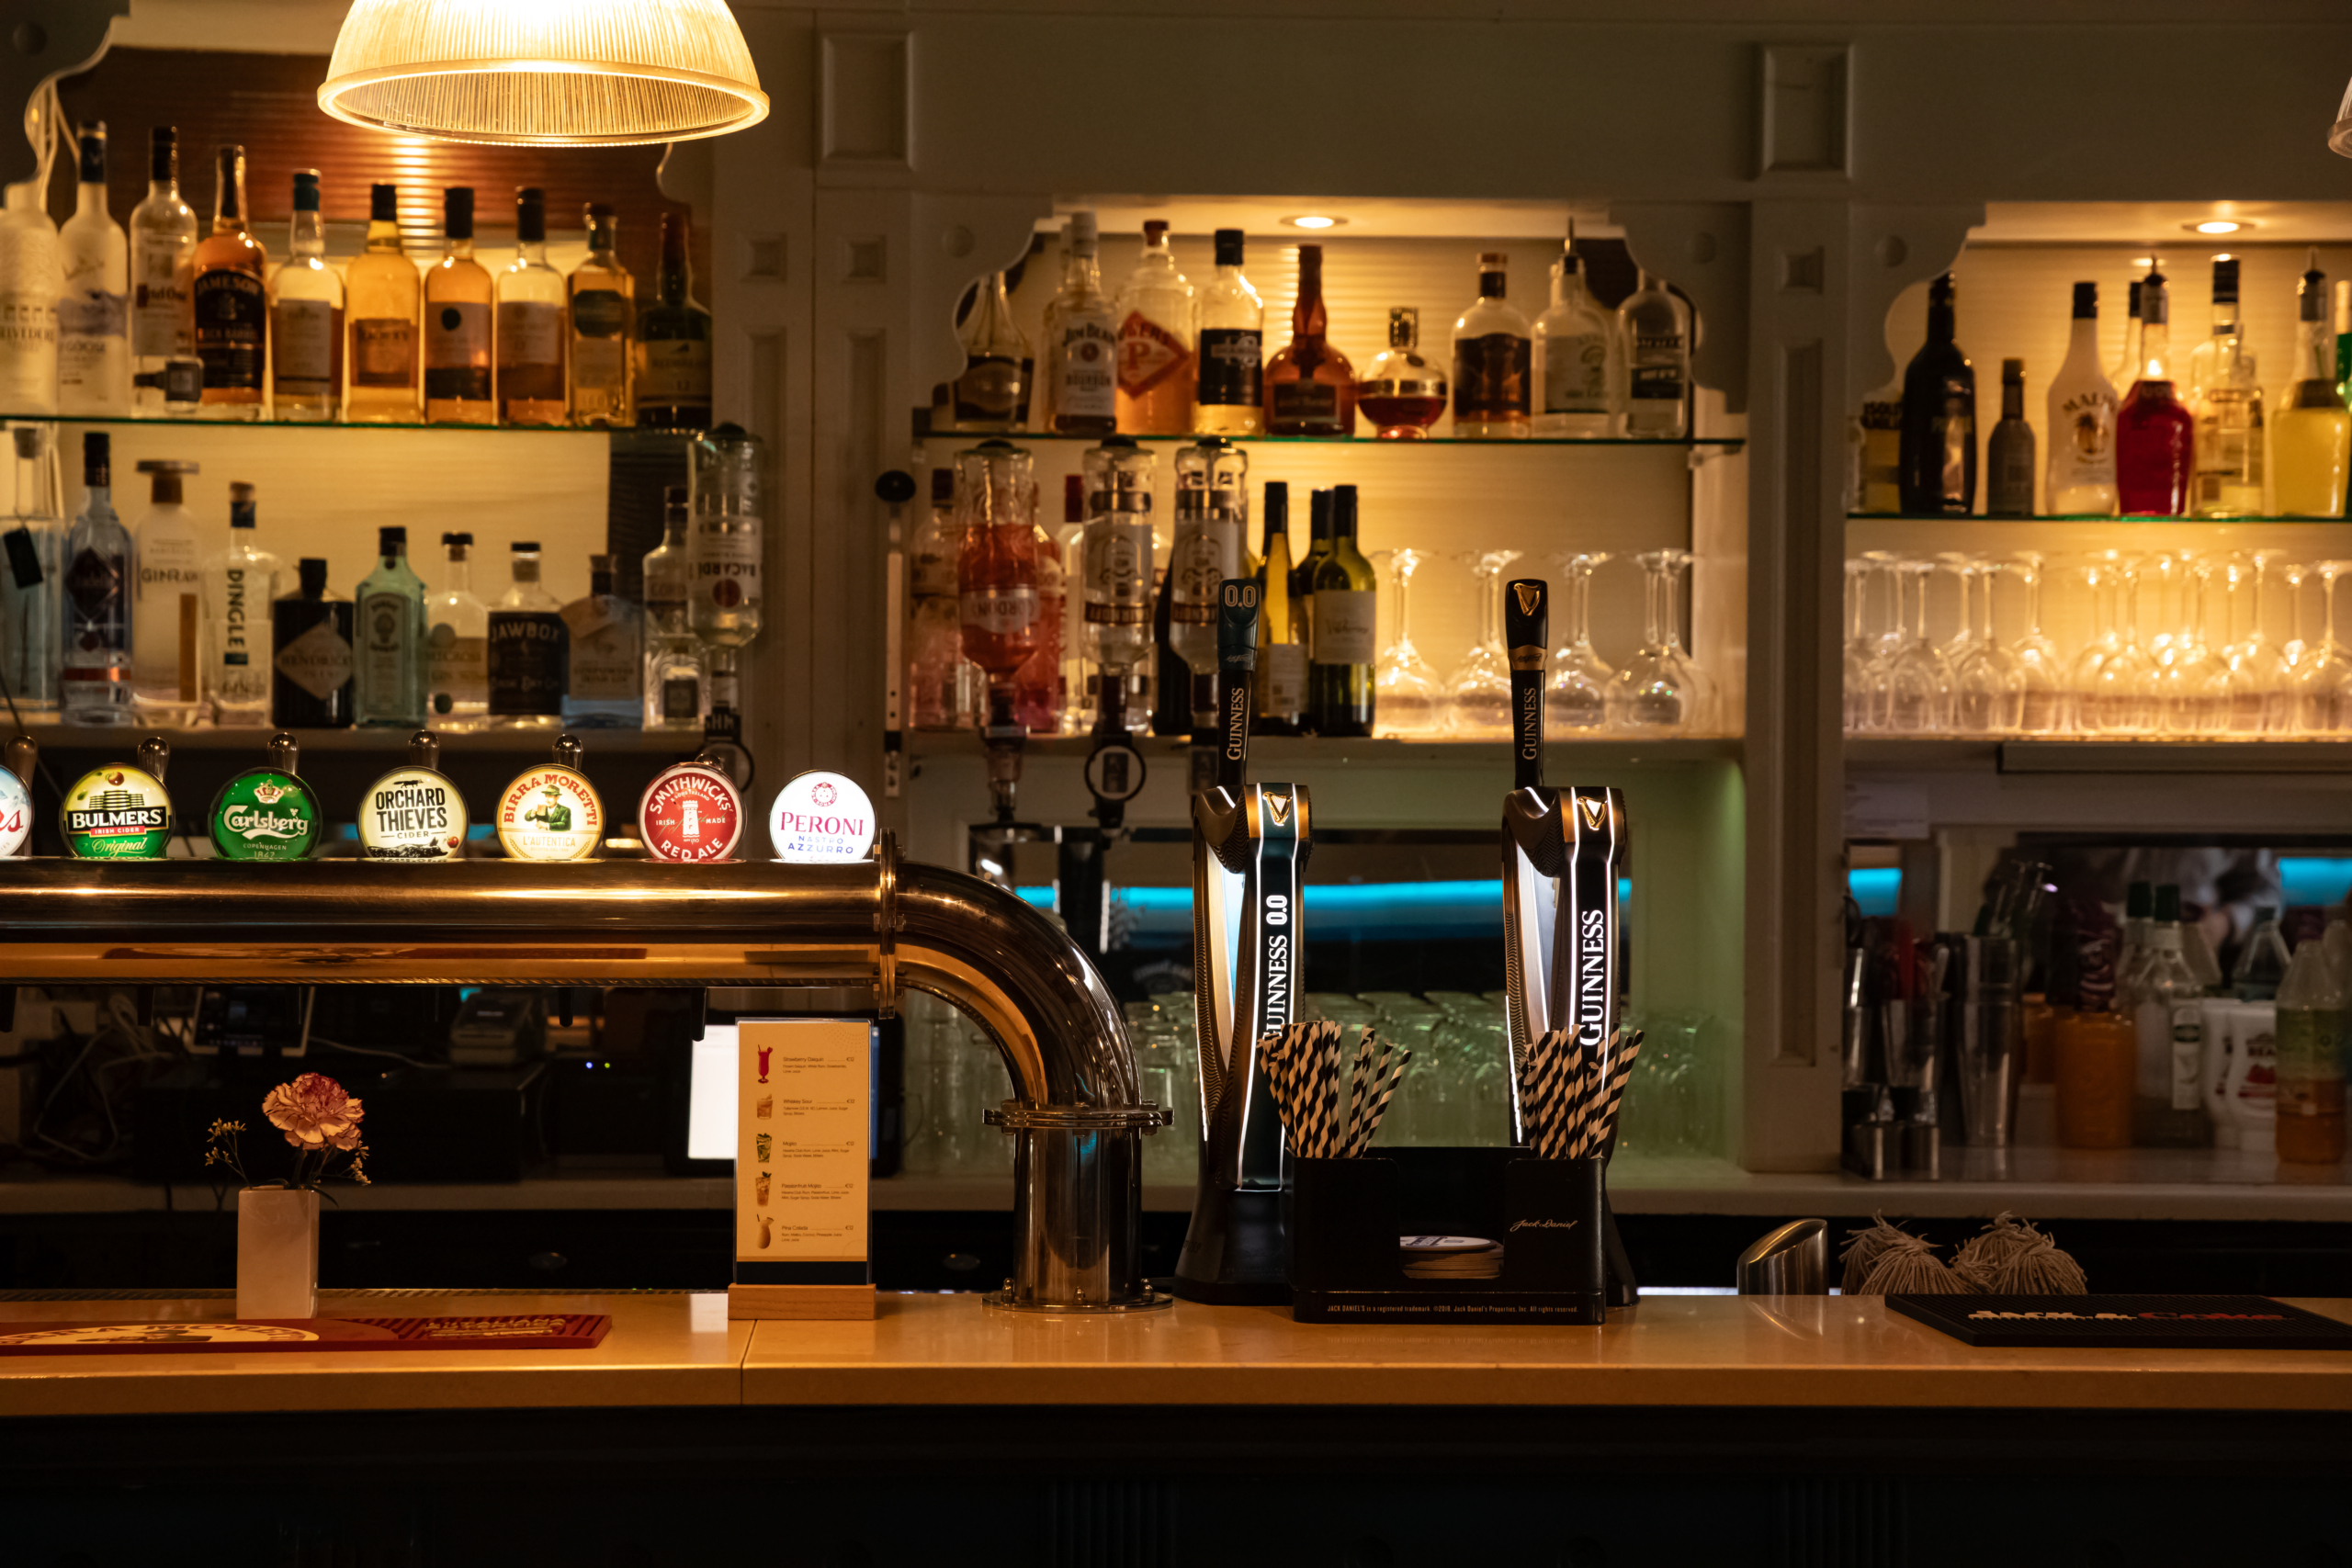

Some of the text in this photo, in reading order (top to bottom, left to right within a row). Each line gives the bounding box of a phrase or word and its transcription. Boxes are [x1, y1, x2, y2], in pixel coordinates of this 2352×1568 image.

[1225, 584, 1256, 608] 0.0
[227, 569, 244, 648] DINGLE
[1227, 687, 1245, 761] GUINNESS
[1521, 687, 1537, 761] GUINNESS
[375, 787, 446, 810] ORCHARD
[503, 773, 597, 826] BIRRA MORETTI
[72, 808, 163, 829] BULMERS
[223, 805, 309, 838] Carlsberg
[376, 807, 447, 832] THIEVES
[705, 817, 726, 825] MADE
[780, 811, 864, 836] PERONI
[397, 830, 429, 840] CIDER
[523, 835, 576, 847] L'AUTENTICA
[798, 835, 843, 844] NASTRO
[91, 837, 149, 858] Original
[243, 842, 287, 851] COPENHAGEN
[254, 851, 276, 859] 1847
[661, 838, 724, 860] RED ALE
[787, 842, 854, 854] AZZURRO
[1265, 895, 1288, 926] 0.0
[1579, 909, 1604, 1046] GUINNESS
[1510, 1219, 1578, 1232] Jack Daniel
[1538, 1305, 1554, 1314] rights
